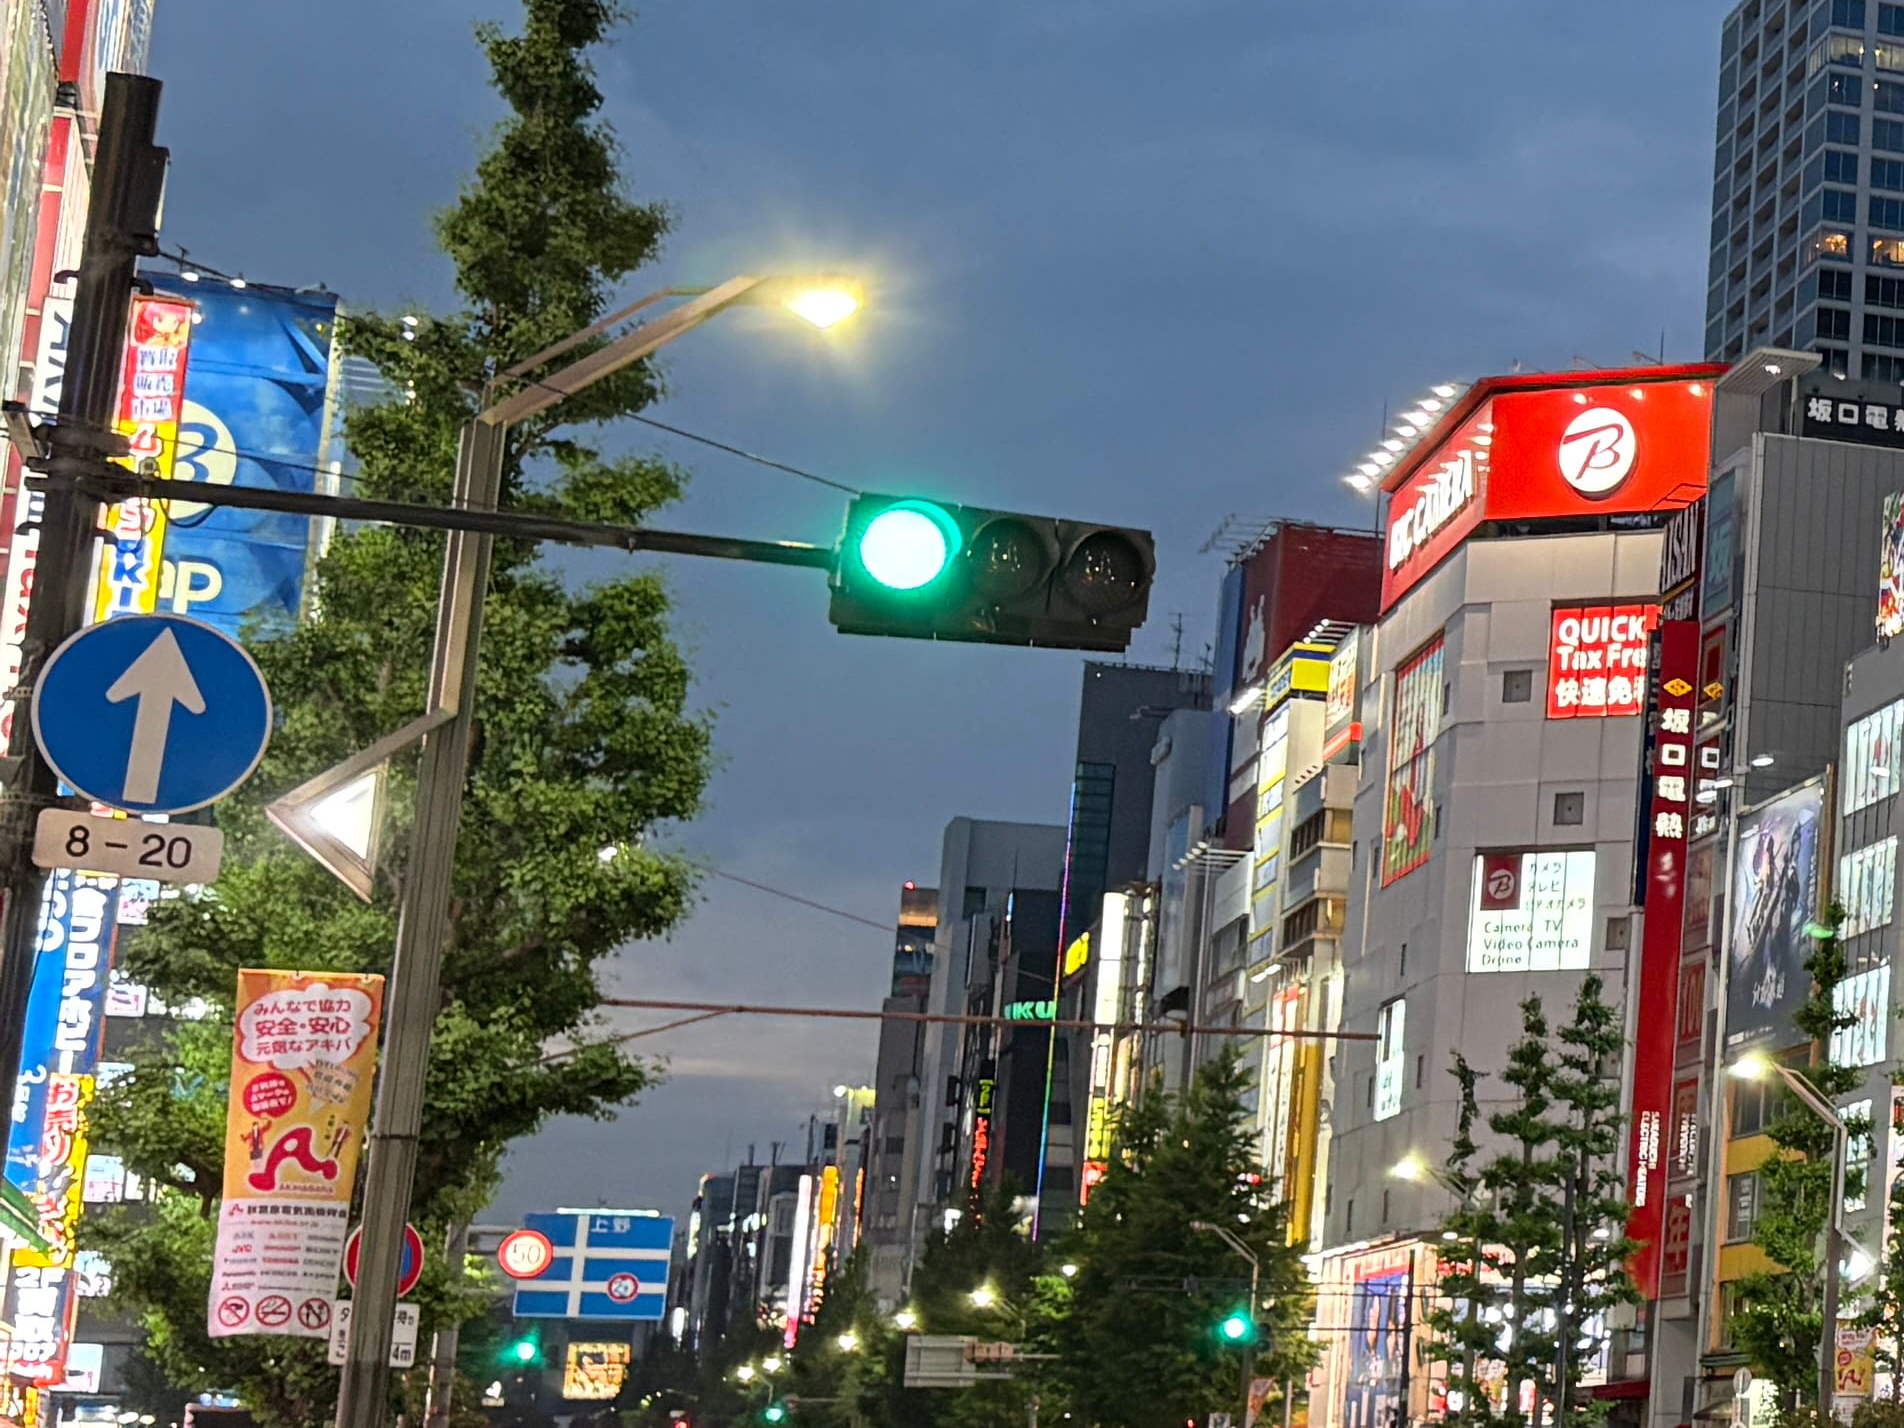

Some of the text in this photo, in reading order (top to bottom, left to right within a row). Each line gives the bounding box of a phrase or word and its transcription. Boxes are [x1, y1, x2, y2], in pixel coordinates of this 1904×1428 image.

[1557, 614, 1649, 645] QUICK
[1557, 644, 1648, 671] Tax Fre
[1655, 707, 1690, 839] 坂口電熱
[1484, 919, 1562, 934] Camera TV
[1483, 936, 1579, 950] Video Camera
[253, 999, 352, 1016] みんなで協力
[255, 1016, 352, 1039] 安全・安心
[256, 1037, 352, 1057] 元気なアキバ
[590, 1216, 631, 1233] 上野
[512, 1243, 541, 1265] 50
